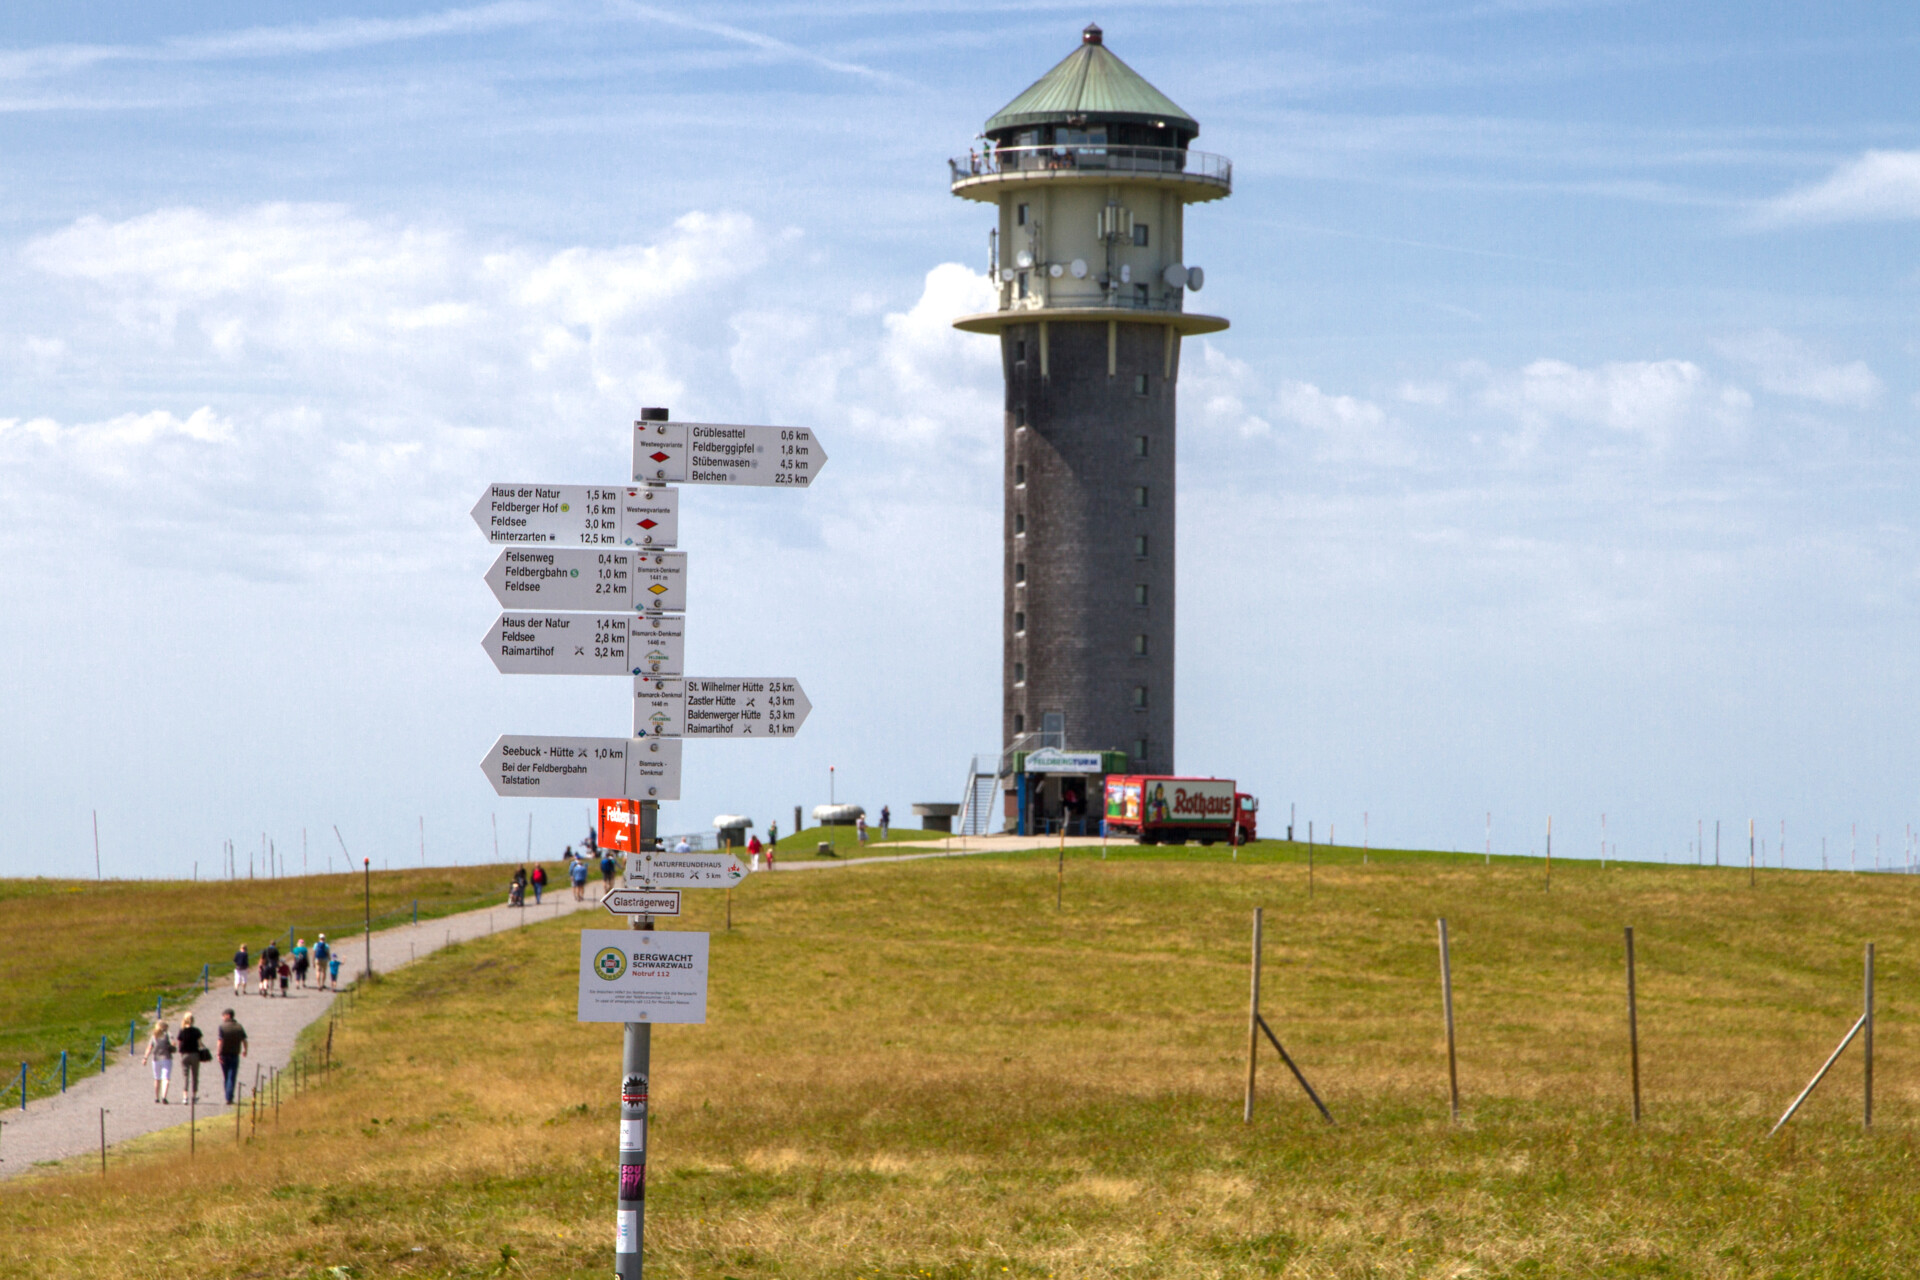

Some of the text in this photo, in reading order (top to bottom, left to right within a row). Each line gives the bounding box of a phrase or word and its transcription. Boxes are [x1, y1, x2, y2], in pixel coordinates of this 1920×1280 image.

[692, 427, 809, 441] Grüblesattel 0,6 km
[640, 441, 683, 449] Westwegvariante
[692, 442, 809, 456] Feldberggipfel 1,8 km
[692, 456, 808, 470] Stübenwasen 4,5 km
[692, 471, 727, 481] Belchen
[775, 473, 792, 484] 22,5
[795, 474, 808, 484] km
[491, 487, 616, 500] Haus der Natur 1,5 km
[491, 502, 539, 513] Feldberger
[542, 503, 558, 513] Hof
[586, 505, 600, 515] 1,6
[602, 505, 615, 515] km
[491, 516, 615, 530] Feldsee 3,0 km
[491, 531, 615, 544] Hinterzarten 12,5 km
[506, 552, 627, 565] Felsenweg 0,4 km
[505, 566, 567, 579] Feldbergbahn
[599, 569, 612, 580] 1,0
[614, 570, 627, 579] km
[505, 581, 627, 594] Feldsee 2,2 km
[502, 618, 625, 629] Haus der Natur 1,4 km
[502, 632, 625, 644] Feldsee 2,8 km
[502, 646, 624, 658] Raimartihof 3,2 km
[688, 682, 794, 692] St. Wilhelmer Hütte 2,5 km
[688, 696, 794, 707] Zastler Hütte 4,3 km
[688, 710, 794, 721] Baldenwerger Hütte 5,3 km
[687, 724, 794, 734] Raimartihof 8,1 km
[502, 746, 541, 756] Seebuck
[550, 747, 574, 758] Hütte
[595, 749, 607, 759] 1,0
[609, 749, 623, 758] km
[502, 763, 587, 774] Bei der Feldbergbahn
[502, 775, 540, 785] Talstation
[1172, 788, 1231, 818] Rothaus
[614, 897, 675, 909] Glasträgerweg
